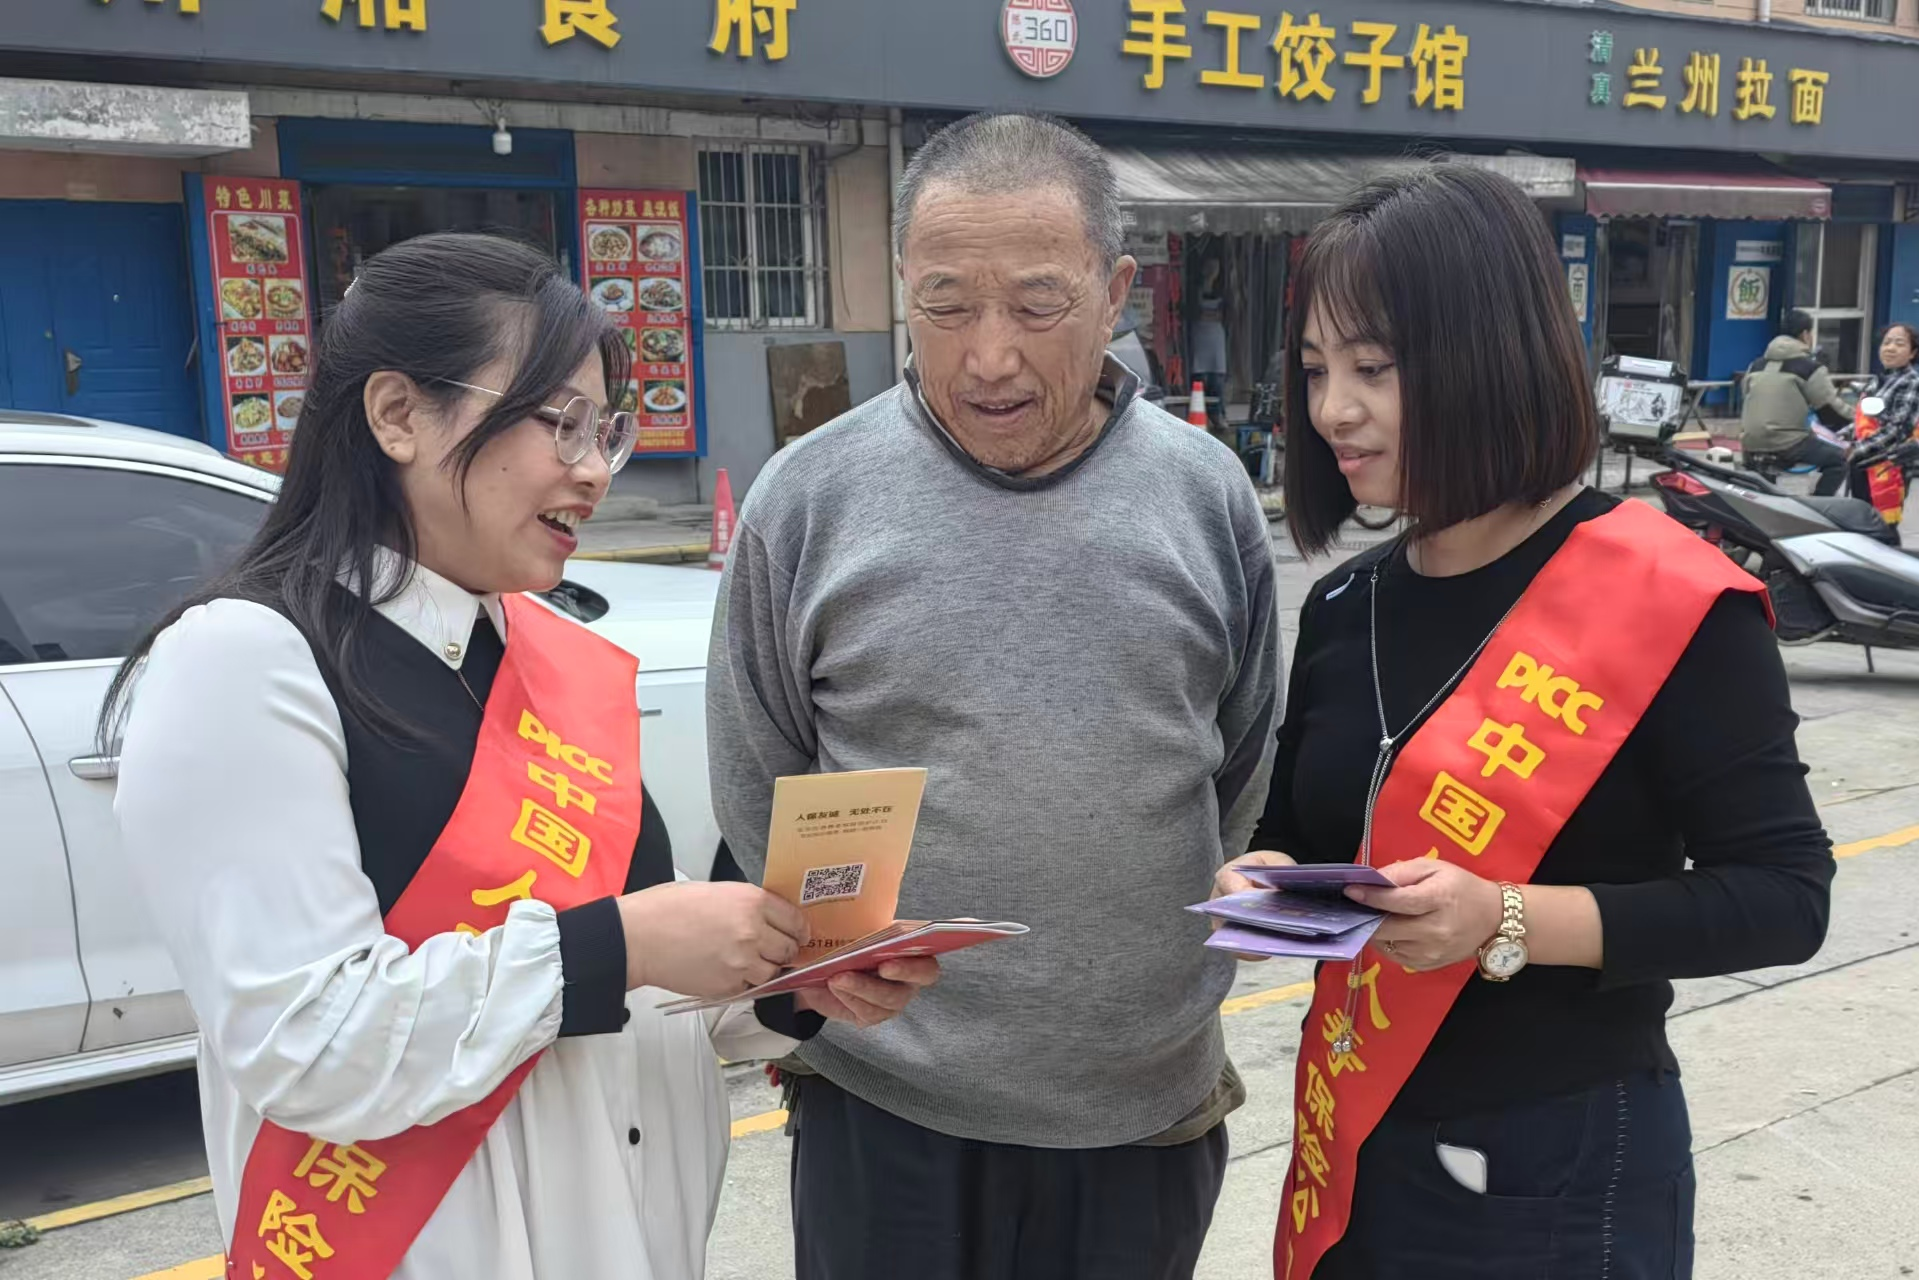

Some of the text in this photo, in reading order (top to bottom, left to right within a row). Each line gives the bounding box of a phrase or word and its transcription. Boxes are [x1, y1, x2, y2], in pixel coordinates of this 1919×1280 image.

[1024, 16, 1068, 43] 360
[1122, 0, 1469, 110] 手工饺子馆
[1588, 29, 1614, 105] 清真
[1622, 47, 1830, 125] 兰州拉面
[214, 184, 293, 210] 特色川菜
[1496, 651, 1604, 735] PICC
[517, 708, 613, 785] PICC
